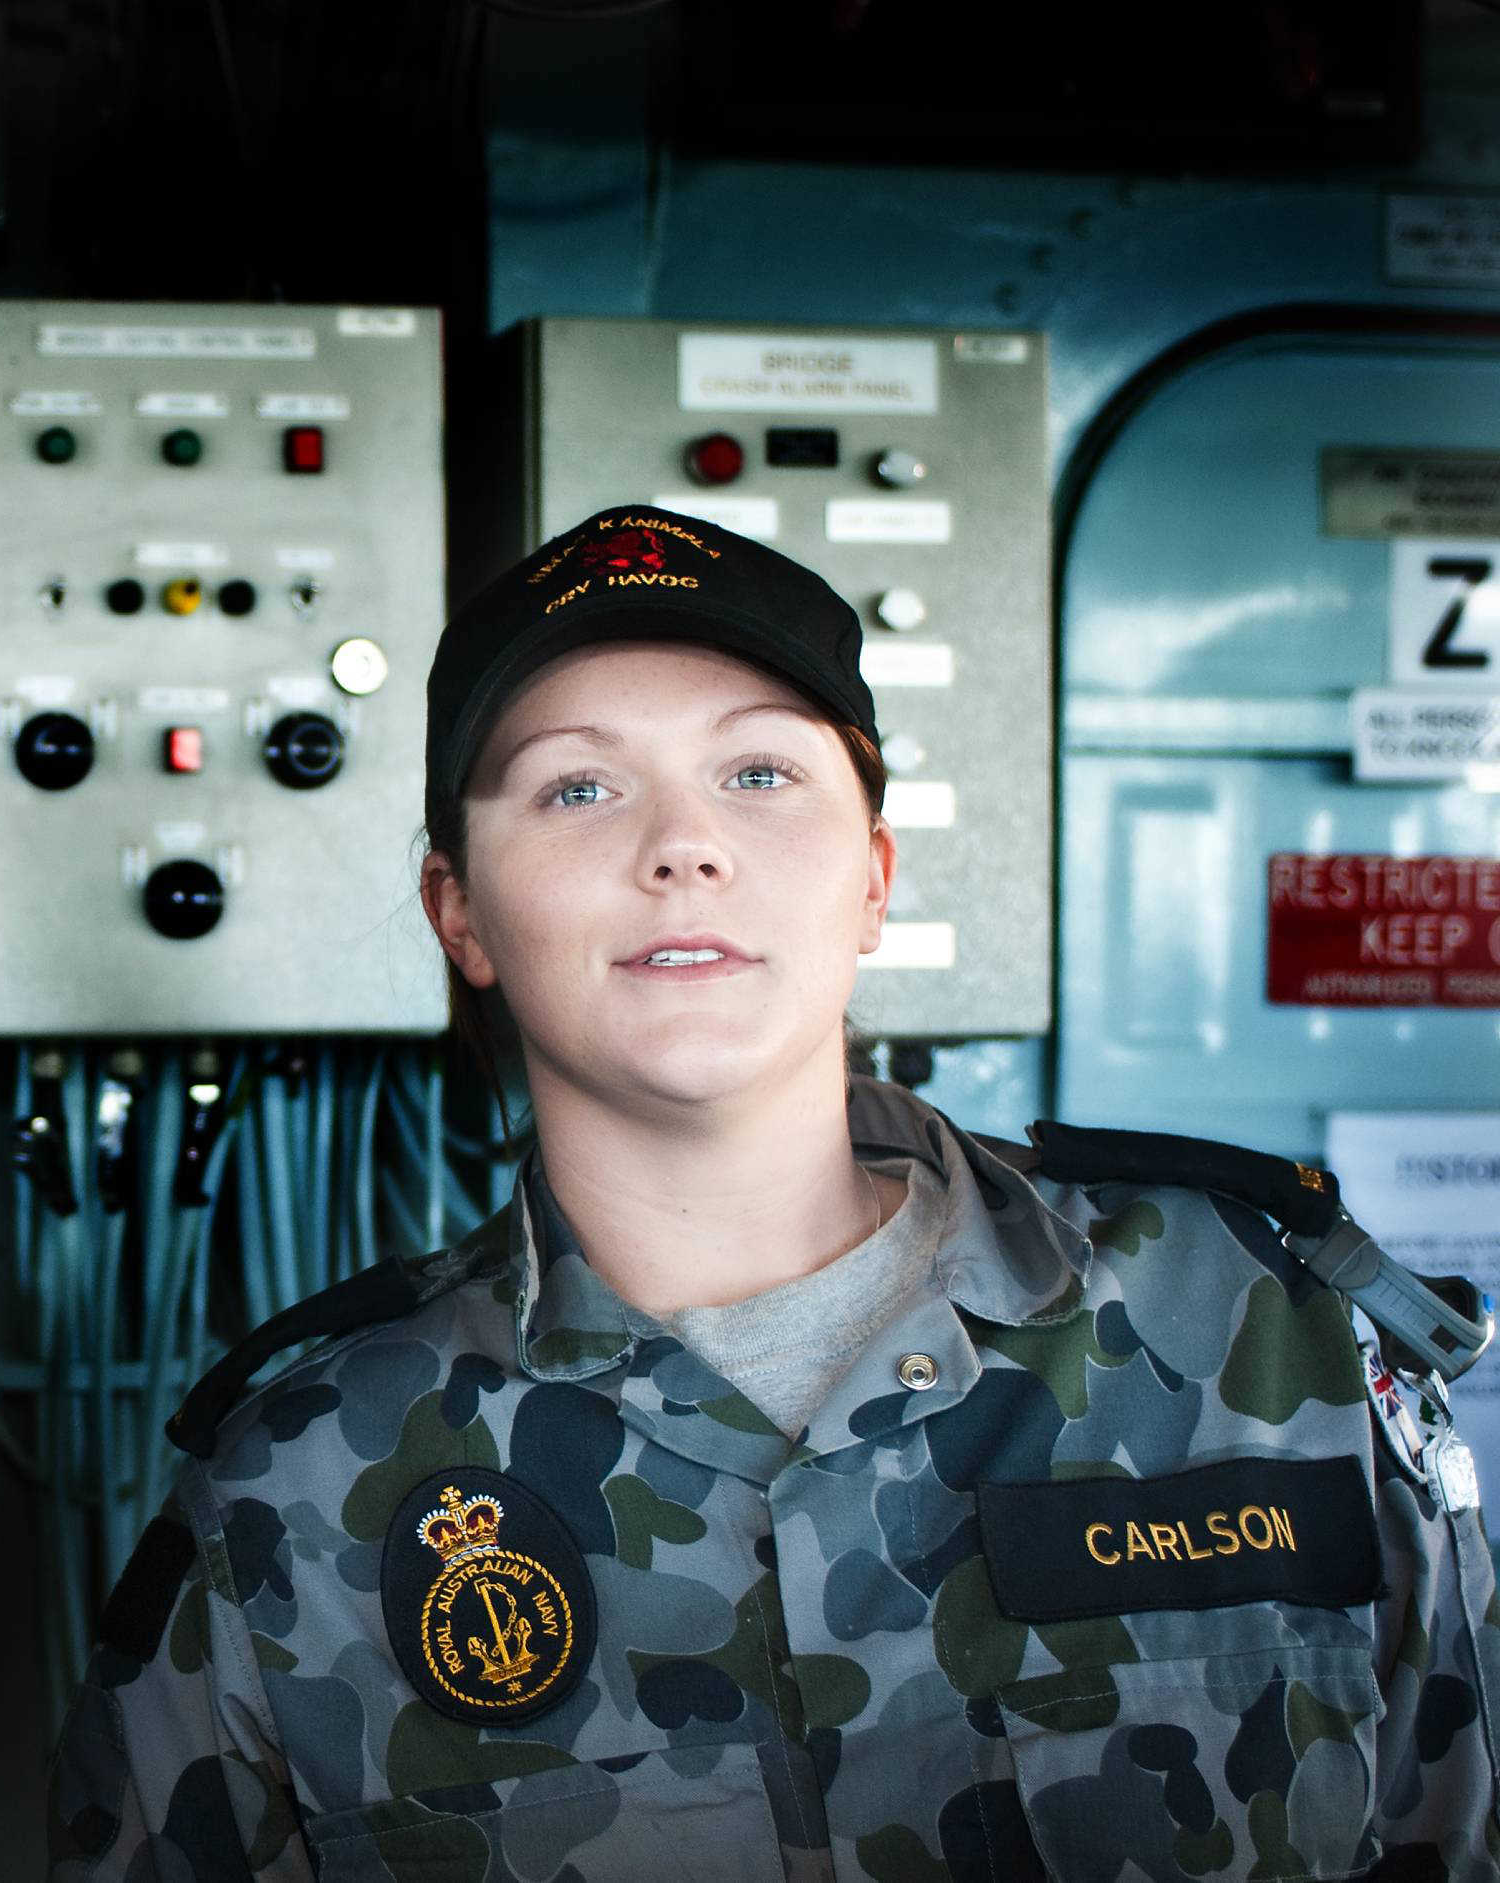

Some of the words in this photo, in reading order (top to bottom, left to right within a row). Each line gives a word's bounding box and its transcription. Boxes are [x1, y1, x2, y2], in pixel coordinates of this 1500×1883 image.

[761, 349, 853, 374] BRIDGE
[608, 572, 700, 589] HAVOC
[1423, 555, 1493, 668] Z
[1360, 913, 1473, 967] KEEP
[1084, 1504, 1297, 1566] CARLSON
[437, 1559, 535, 1614] AUSTRALIAN
[531, 1590, 559, 1637] NAVY
[435, 1619, 466, 1675] ROYAL
